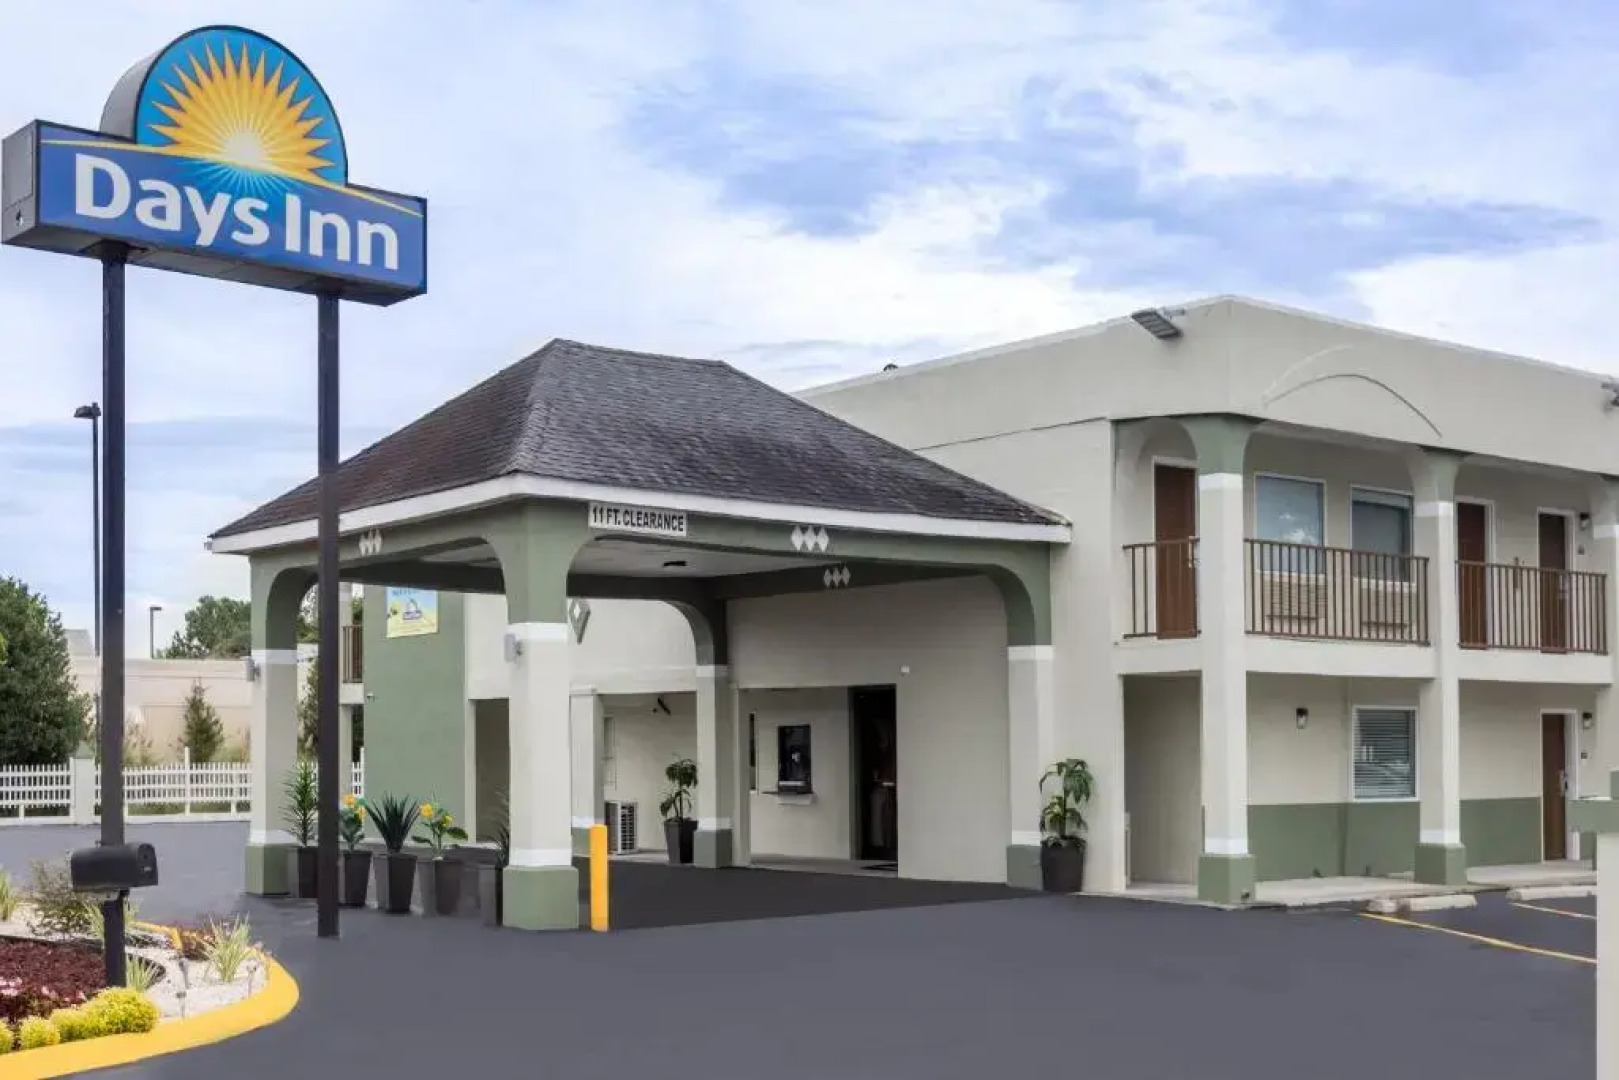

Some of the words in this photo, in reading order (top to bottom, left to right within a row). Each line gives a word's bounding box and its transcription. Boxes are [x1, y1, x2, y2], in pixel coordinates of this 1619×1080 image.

[75, 153, 270, 246] Days
[285, 193, 399, 270] Inn
[592, 506, 603, 524] 11
[606, 508, 621, 526] FT.
[623, 508, 684, 532] CLEARANCE
